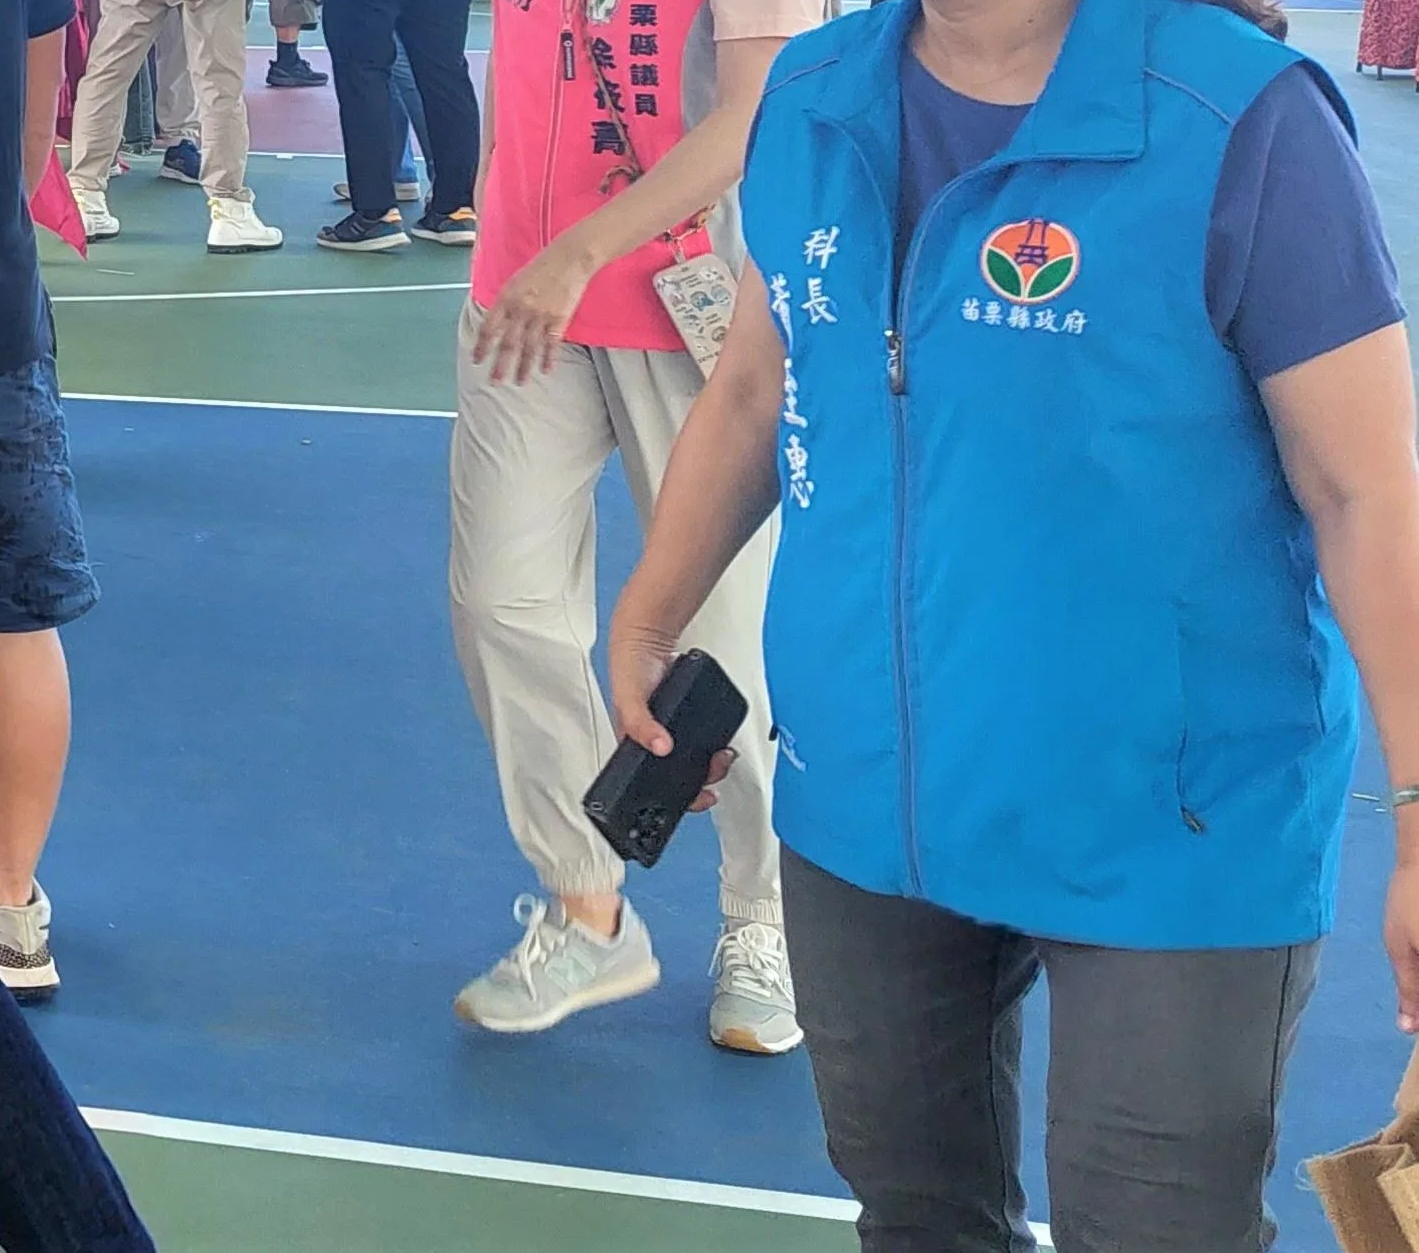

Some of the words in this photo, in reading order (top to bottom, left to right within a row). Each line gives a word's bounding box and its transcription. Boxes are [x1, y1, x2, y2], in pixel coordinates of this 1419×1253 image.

[802, 226, 840, 325] 科長
[961, 297, 1088, 335] 苗栗縣政府
